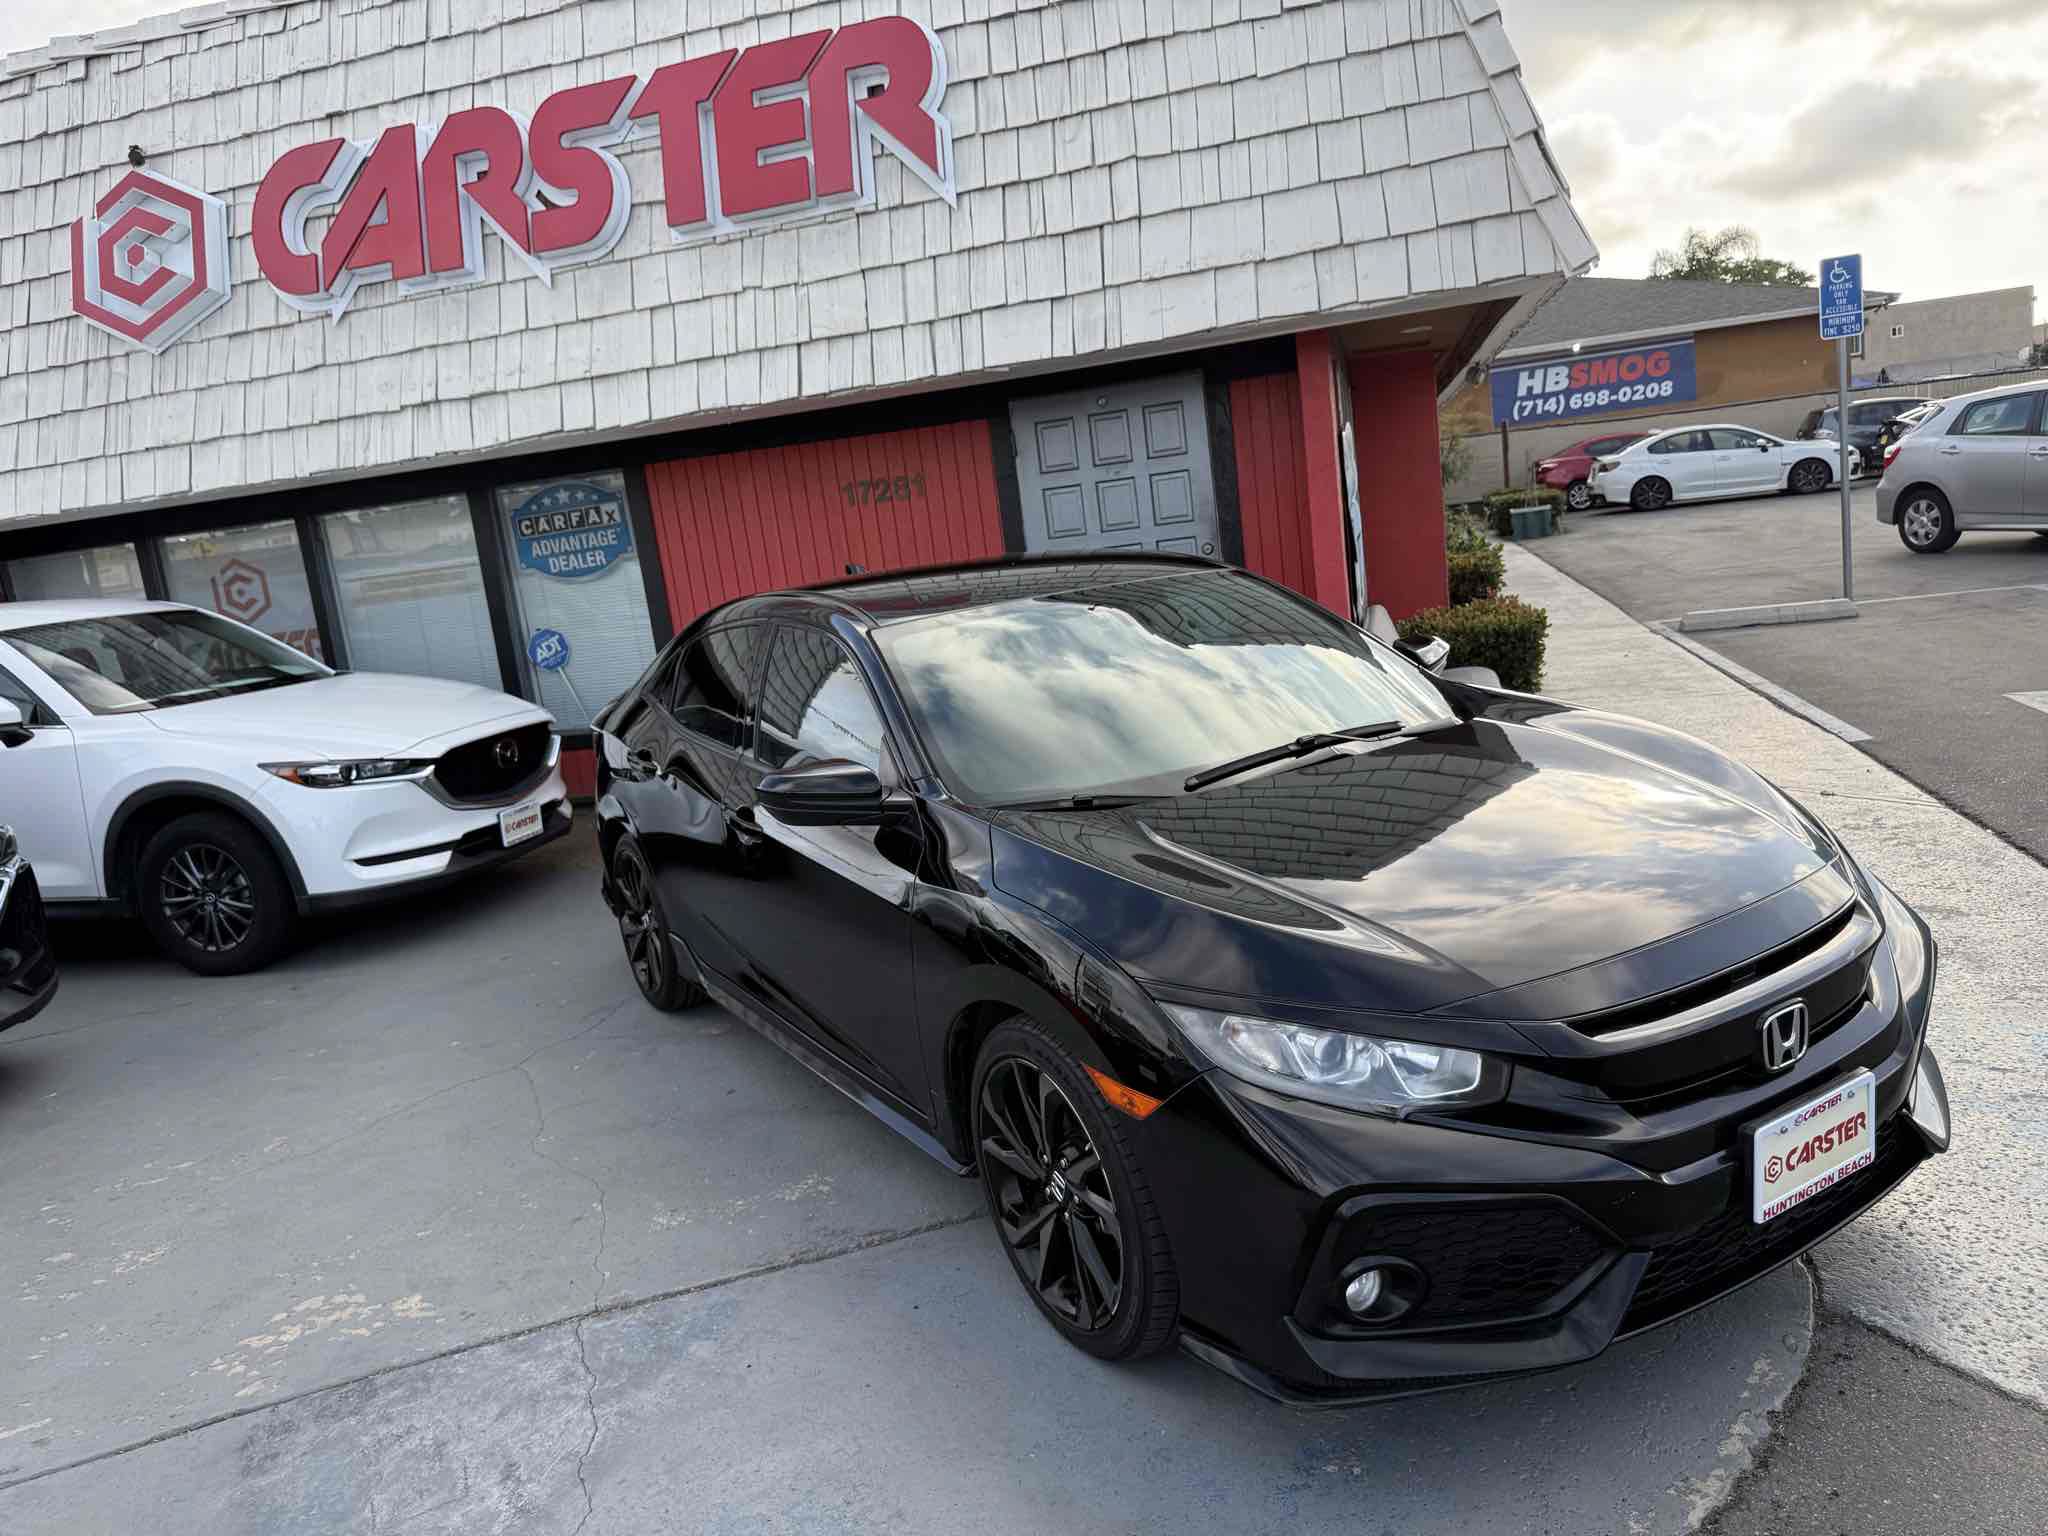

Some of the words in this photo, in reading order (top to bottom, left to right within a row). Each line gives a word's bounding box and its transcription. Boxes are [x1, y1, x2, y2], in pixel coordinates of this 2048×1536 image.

[252, 16, 956, 314] CARSTER
[1828, 316, 1856, 325] MINIMUM
[1513, 394, 1565, 421] (714)
[1569, 380, 1673, 409] 698-0208
[841, 471, 928, 507] 17281
[518, 506, 620, 536] CARFAX
[531, 528, 617, 559] ADVANTAGE
[549, 550, 607, 574] DEALER
[536, 635, 562, 663] ADT
[1803, 1092, 1842, 1122] CARSTER
[1785, 1111, 1867, 1172] CARSTER
[1763, 1173, 1835, 1221] HUNTINGTON
[1837, 1151, 1873, 1179] BEACH
